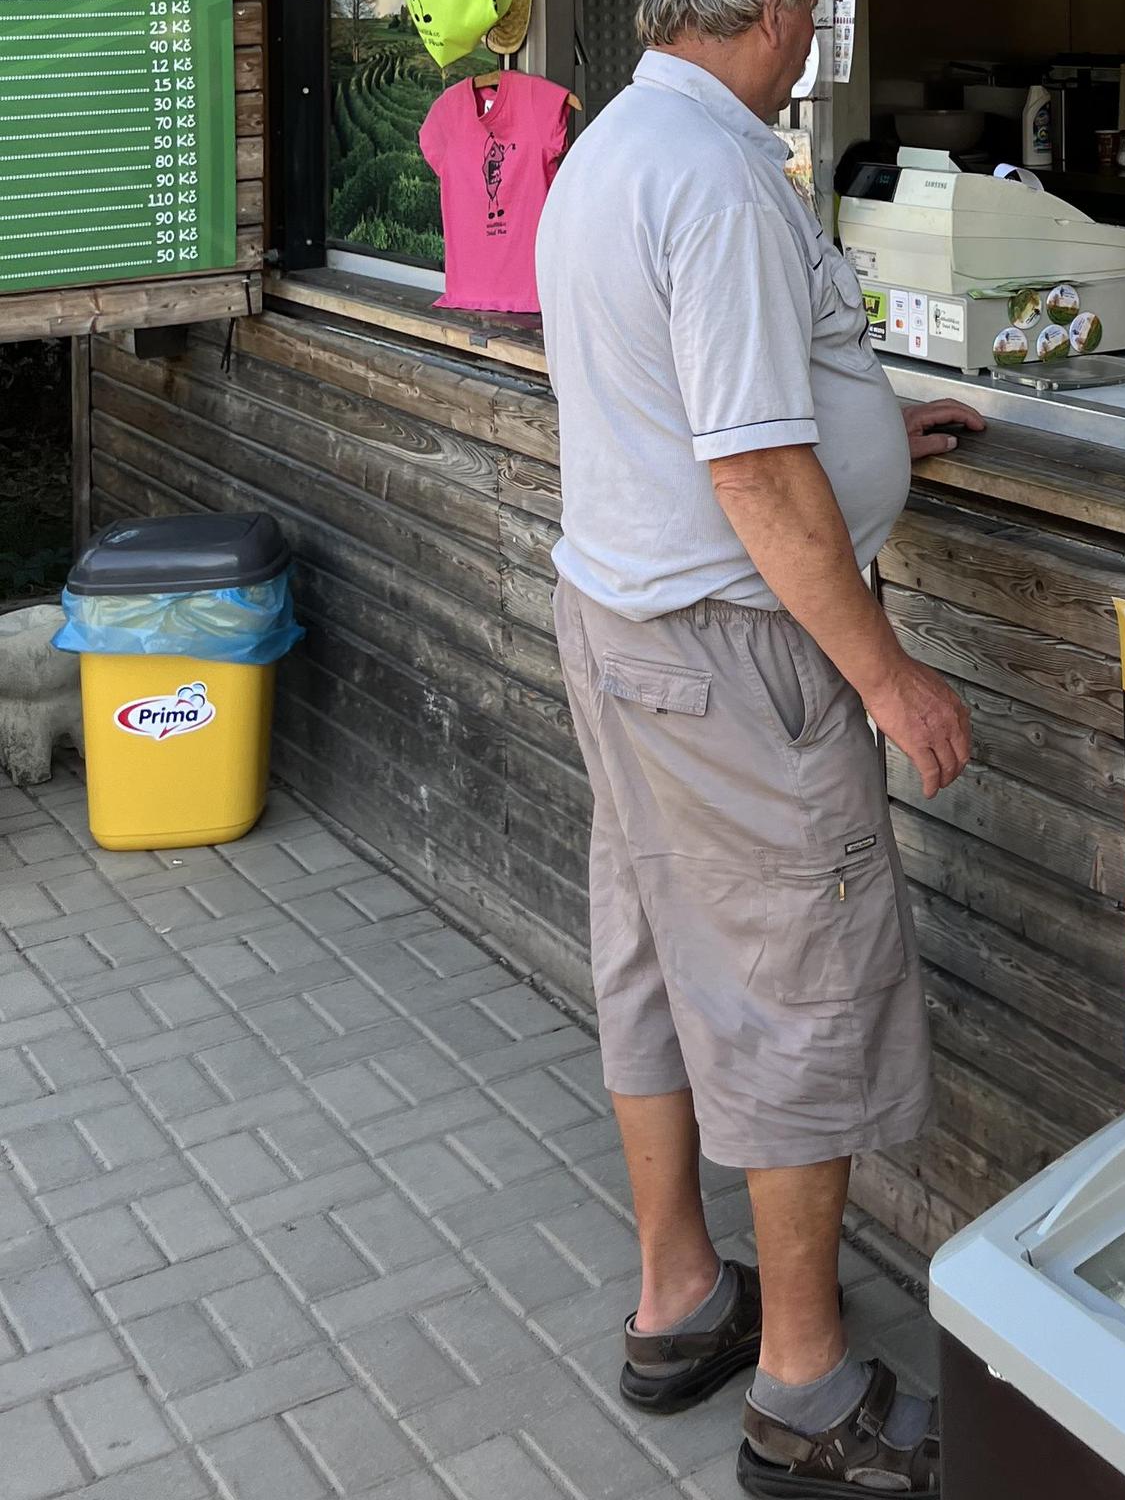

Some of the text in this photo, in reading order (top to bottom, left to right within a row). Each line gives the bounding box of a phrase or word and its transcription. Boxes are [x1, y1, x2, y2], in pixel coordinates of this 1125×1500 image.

[150, 2, 167, 15] 18
[150, 22, 166, 34] 23
[150, 41, 168, 53] 40
[151, 60, 169, 73] 12
[154, 79, 171, 92] 15
[154, 99, 171, 111] 30
[155, 118, 172, 130] 70
[154, 136, 172, 149] 50
[155, 155, 173, 168] 80
[156, 175, 174, 187] 90
[148, 194, 173, 207] 110
[156, 212, 173, 225] 90
[156, 231, 174, 244] 50
[157, 249, 174, 263] 50
[138, 707, 199, 725] Prima
